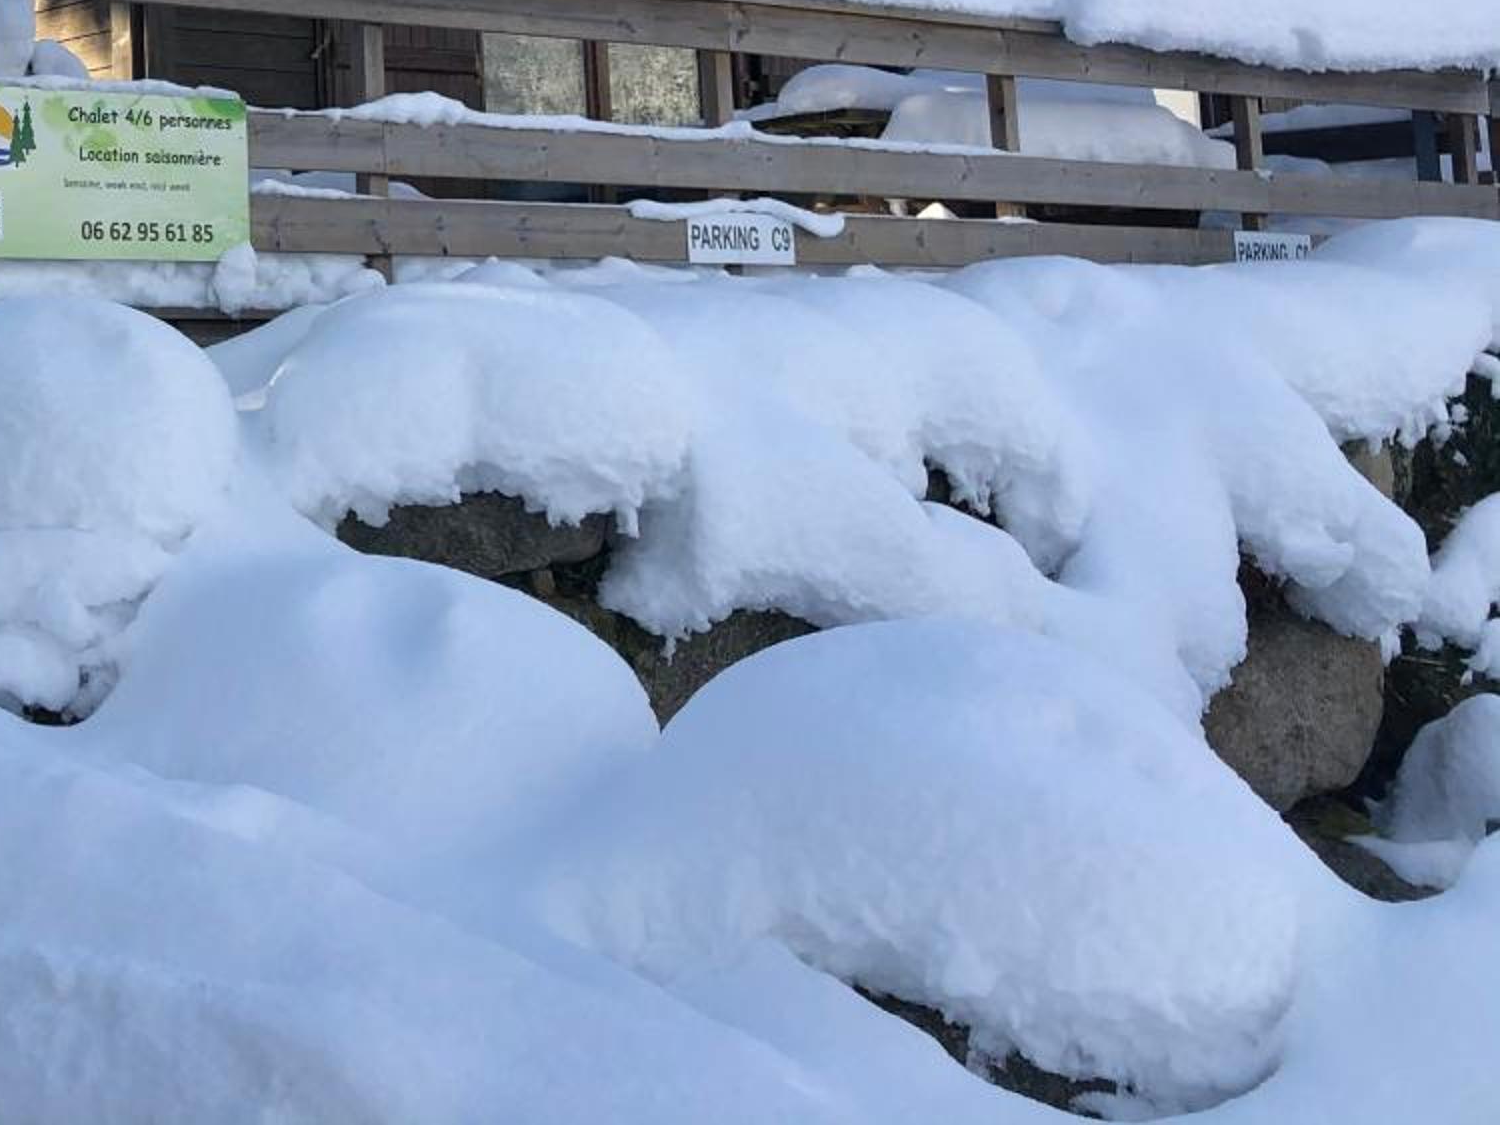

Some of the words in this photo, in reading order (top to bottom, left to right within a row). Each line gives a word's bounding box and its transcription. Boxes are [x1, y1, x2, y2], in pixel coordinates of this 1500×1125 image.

[68, 106, 118, 124] Chalet
[125, 108, 152, 126] 4/6
[160, 115, 232, 131] personnes
[79, 146, 139, 163] Location
[145, 151, 221, 167] saisonnière
[81, 221, 104, 240] 06
[109, 222, 132, 241] 62
[137, 222, 159, 242] 95
[165, 223, 187, 242] 61
[192, 224, 214, 243] 85
[691, 225, 760, 250] PARKING
[771, 226, 790, 251] C9
[1238, 242, 1288, 261] PARKING
